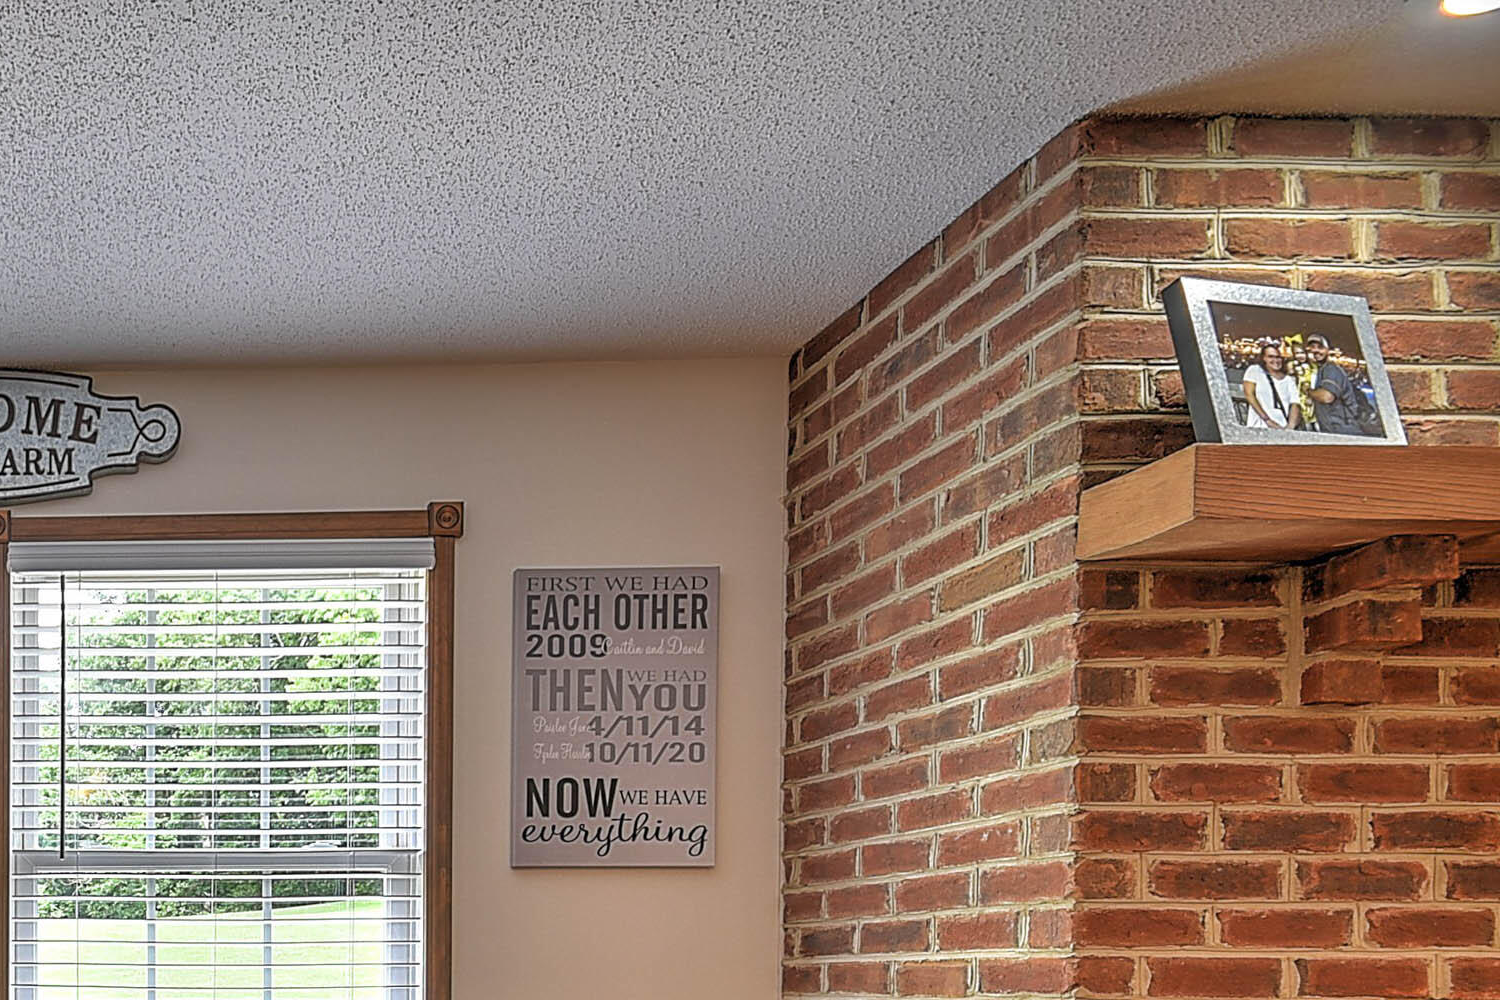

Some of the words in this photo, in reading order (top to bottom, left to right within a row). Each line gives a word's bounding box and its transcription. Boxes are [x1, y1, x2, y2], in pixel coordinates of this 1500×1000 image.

[527, 576, 596, 591] FIRST
[605, 576, 644, 590] WE
[653, 575, 709, 591] HAD
[526, 594, 600, 630] EACH
[614, 593, 708, 630] OTHER
[525, 633, 608, 658] 2009
[645, 638, 664, 655] and
[666, 635, 705, 655] David
[627, 670, 656, 681] WE
[664, 670, 707, 682] HAD
[525, 668, 624, 712] THEN
[628, 683, 706, 711] YOU
[588, 715, 706, 738] 4/11/14
[585, 742, 706, 765] 10/11/20
[526, 777, 618, 818] NOW
[620, 790, 648, 805] WE
[655, 790, 707, 805] HAVE
[522, 812, 708, 857] everything
